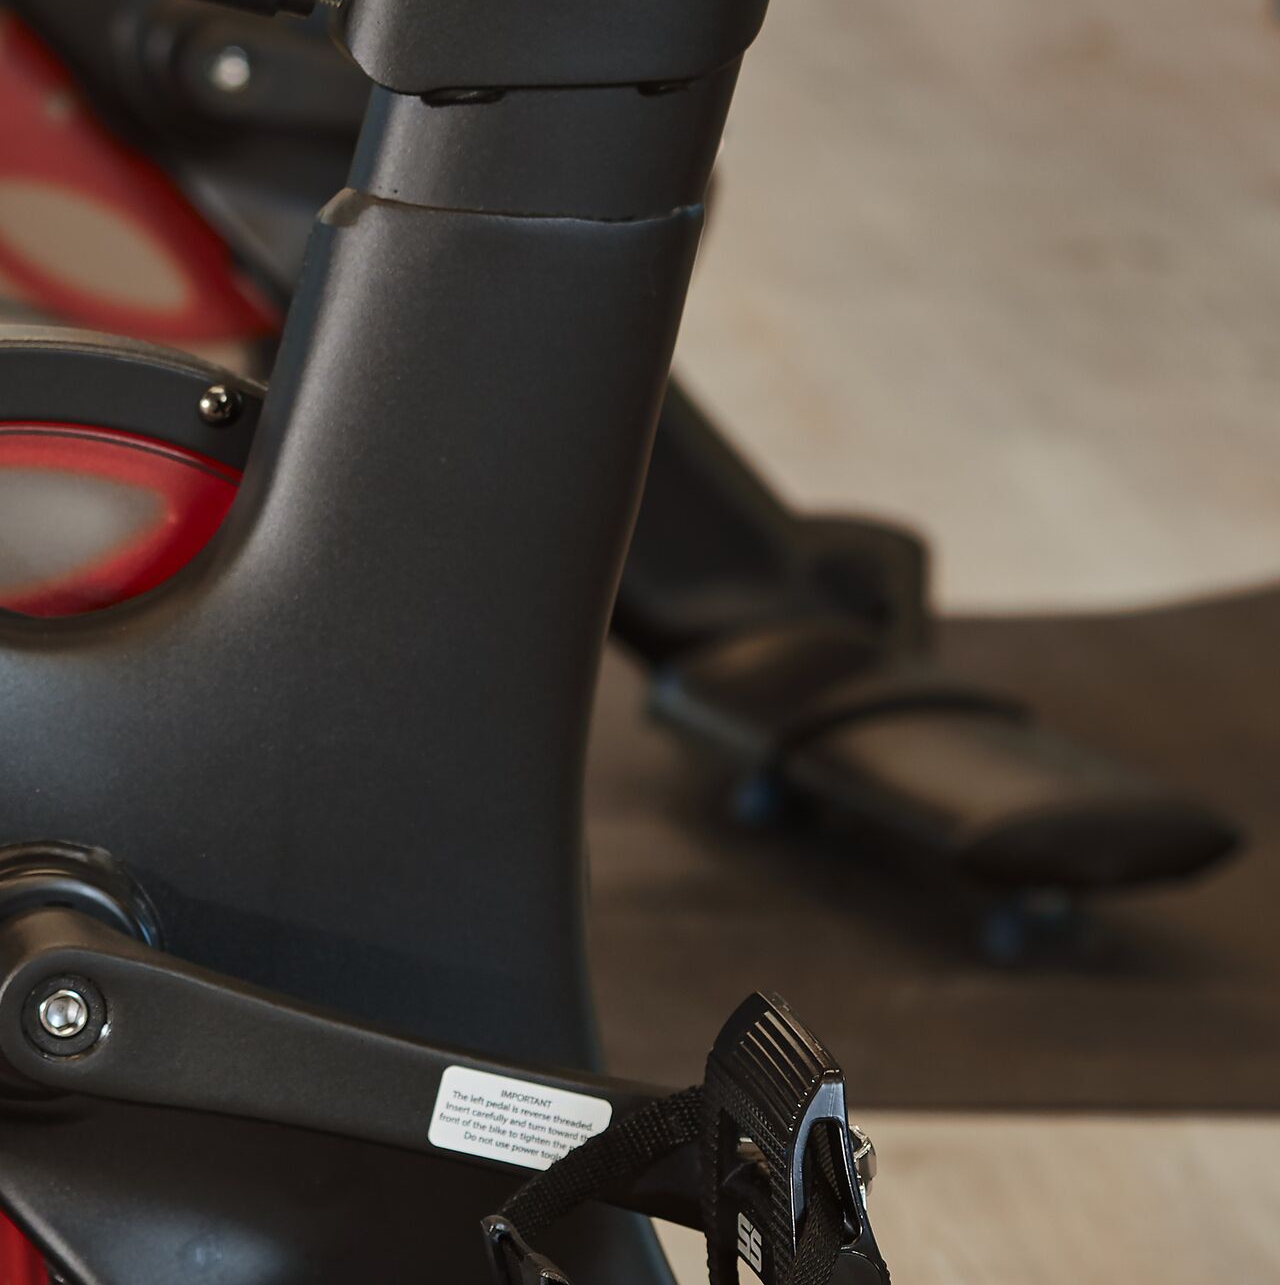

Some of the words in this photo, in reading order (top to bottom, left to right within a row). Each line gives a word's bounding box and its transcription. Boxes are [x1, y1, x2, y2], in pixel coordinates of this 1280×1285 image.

[452, 1091, 469, 1101] The
[470, 1095, 484, 1105] left
[486, 1099, 511, 1113] pedal
[512, 1105, 519, 1113] is
[520, 1109, 551, 1121] reverse
[500, 1090, 552, 1109] IMPORTANT
[439, 1113, 460, 1125] front
[462, 1119, 472, 1127] of
[473, 1121, 486, 1131] the
[489, 1125, 507, 1136] bike
[519, 1132, 550, 1147] tighten
[552, 1140, 567, 1150] the
[446, 1102, 471, 1114] Insert
[471, 1108, 508, 1125] carefully
[510, 1117, 526, 1128] and
[528, 1122, 546, 1133] turn
[548, 1126, 579, 1141] toward
[464, 1132, 476, 1141] Do
[478, 1136, 493, 1145] not
[495, 1141, 509, 1149] use
[511, 1145, 538, 1157] power
